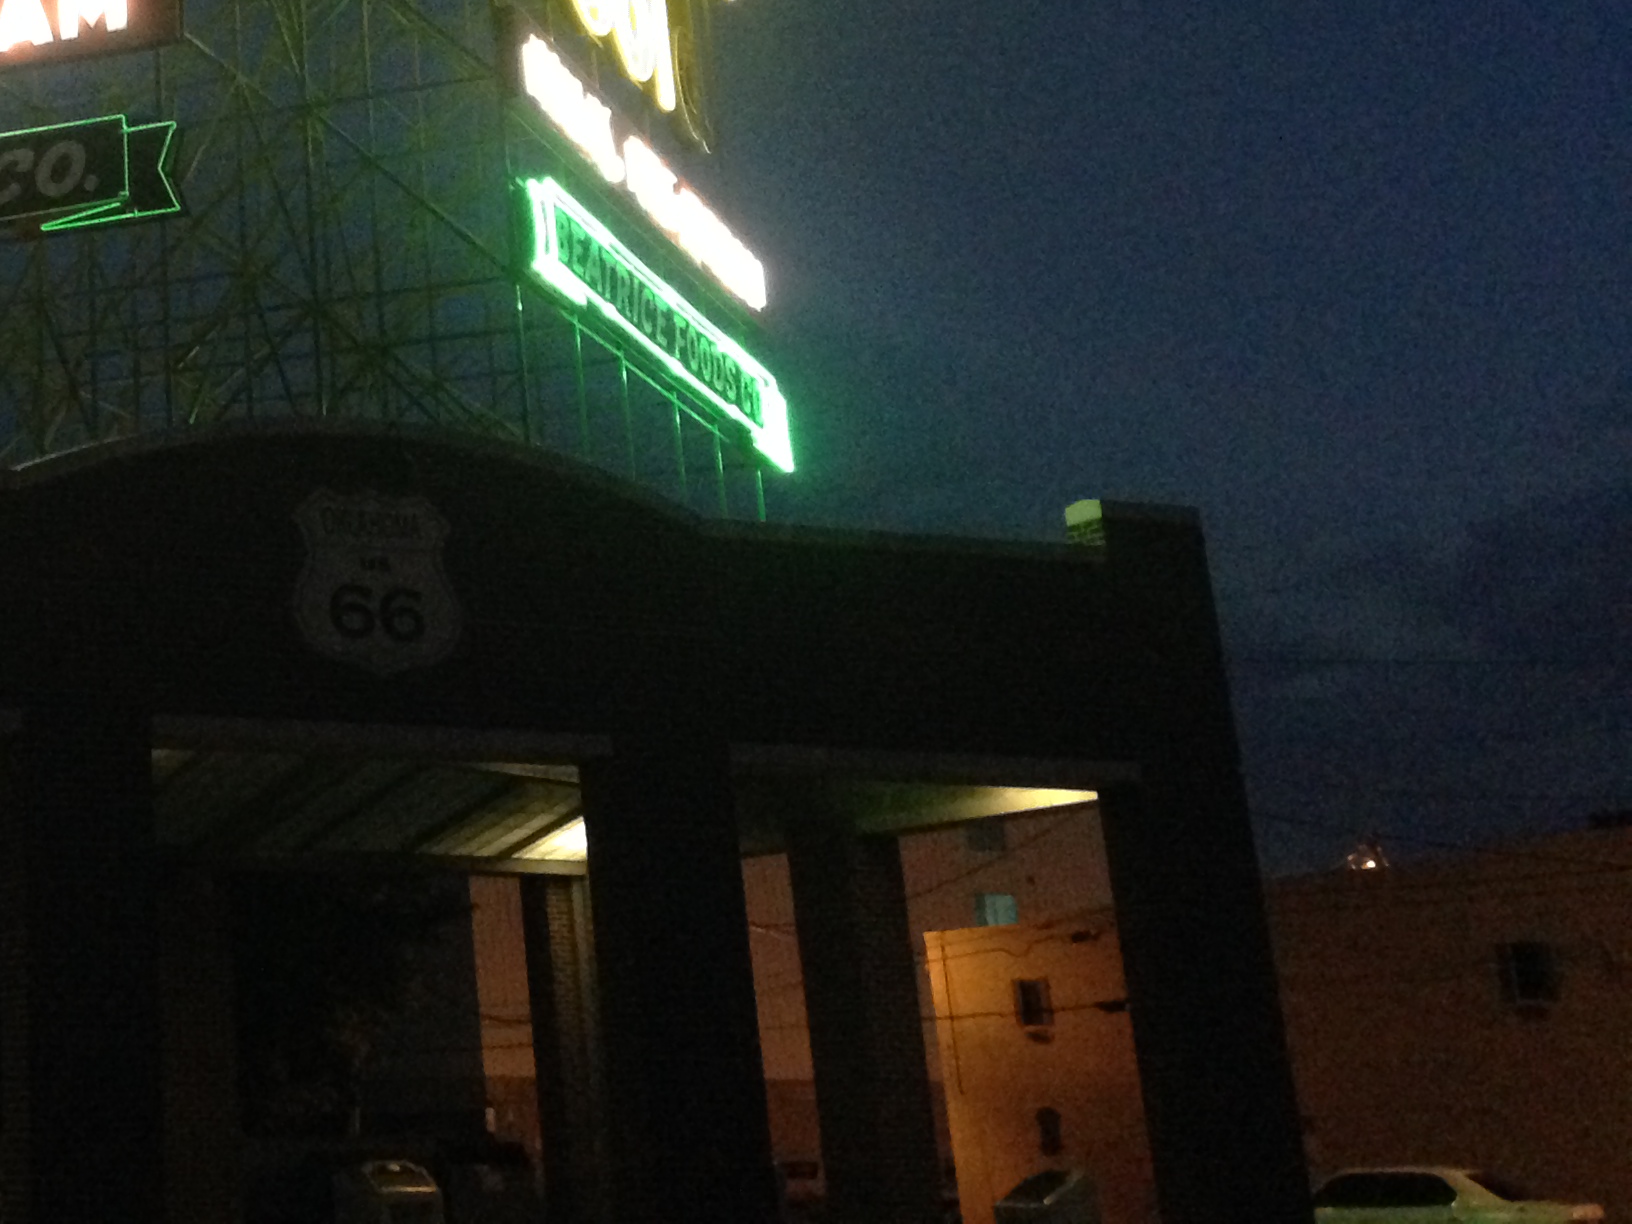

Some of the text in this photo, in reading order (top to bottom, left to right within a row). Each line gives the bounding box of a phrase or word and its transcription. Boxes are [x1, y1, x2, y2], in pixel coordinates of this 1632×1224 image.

[555, 205, 669, 346] BEATRICE
[673, 312, 737, 403] FOODS
[329, 583, 426, 643] 66
